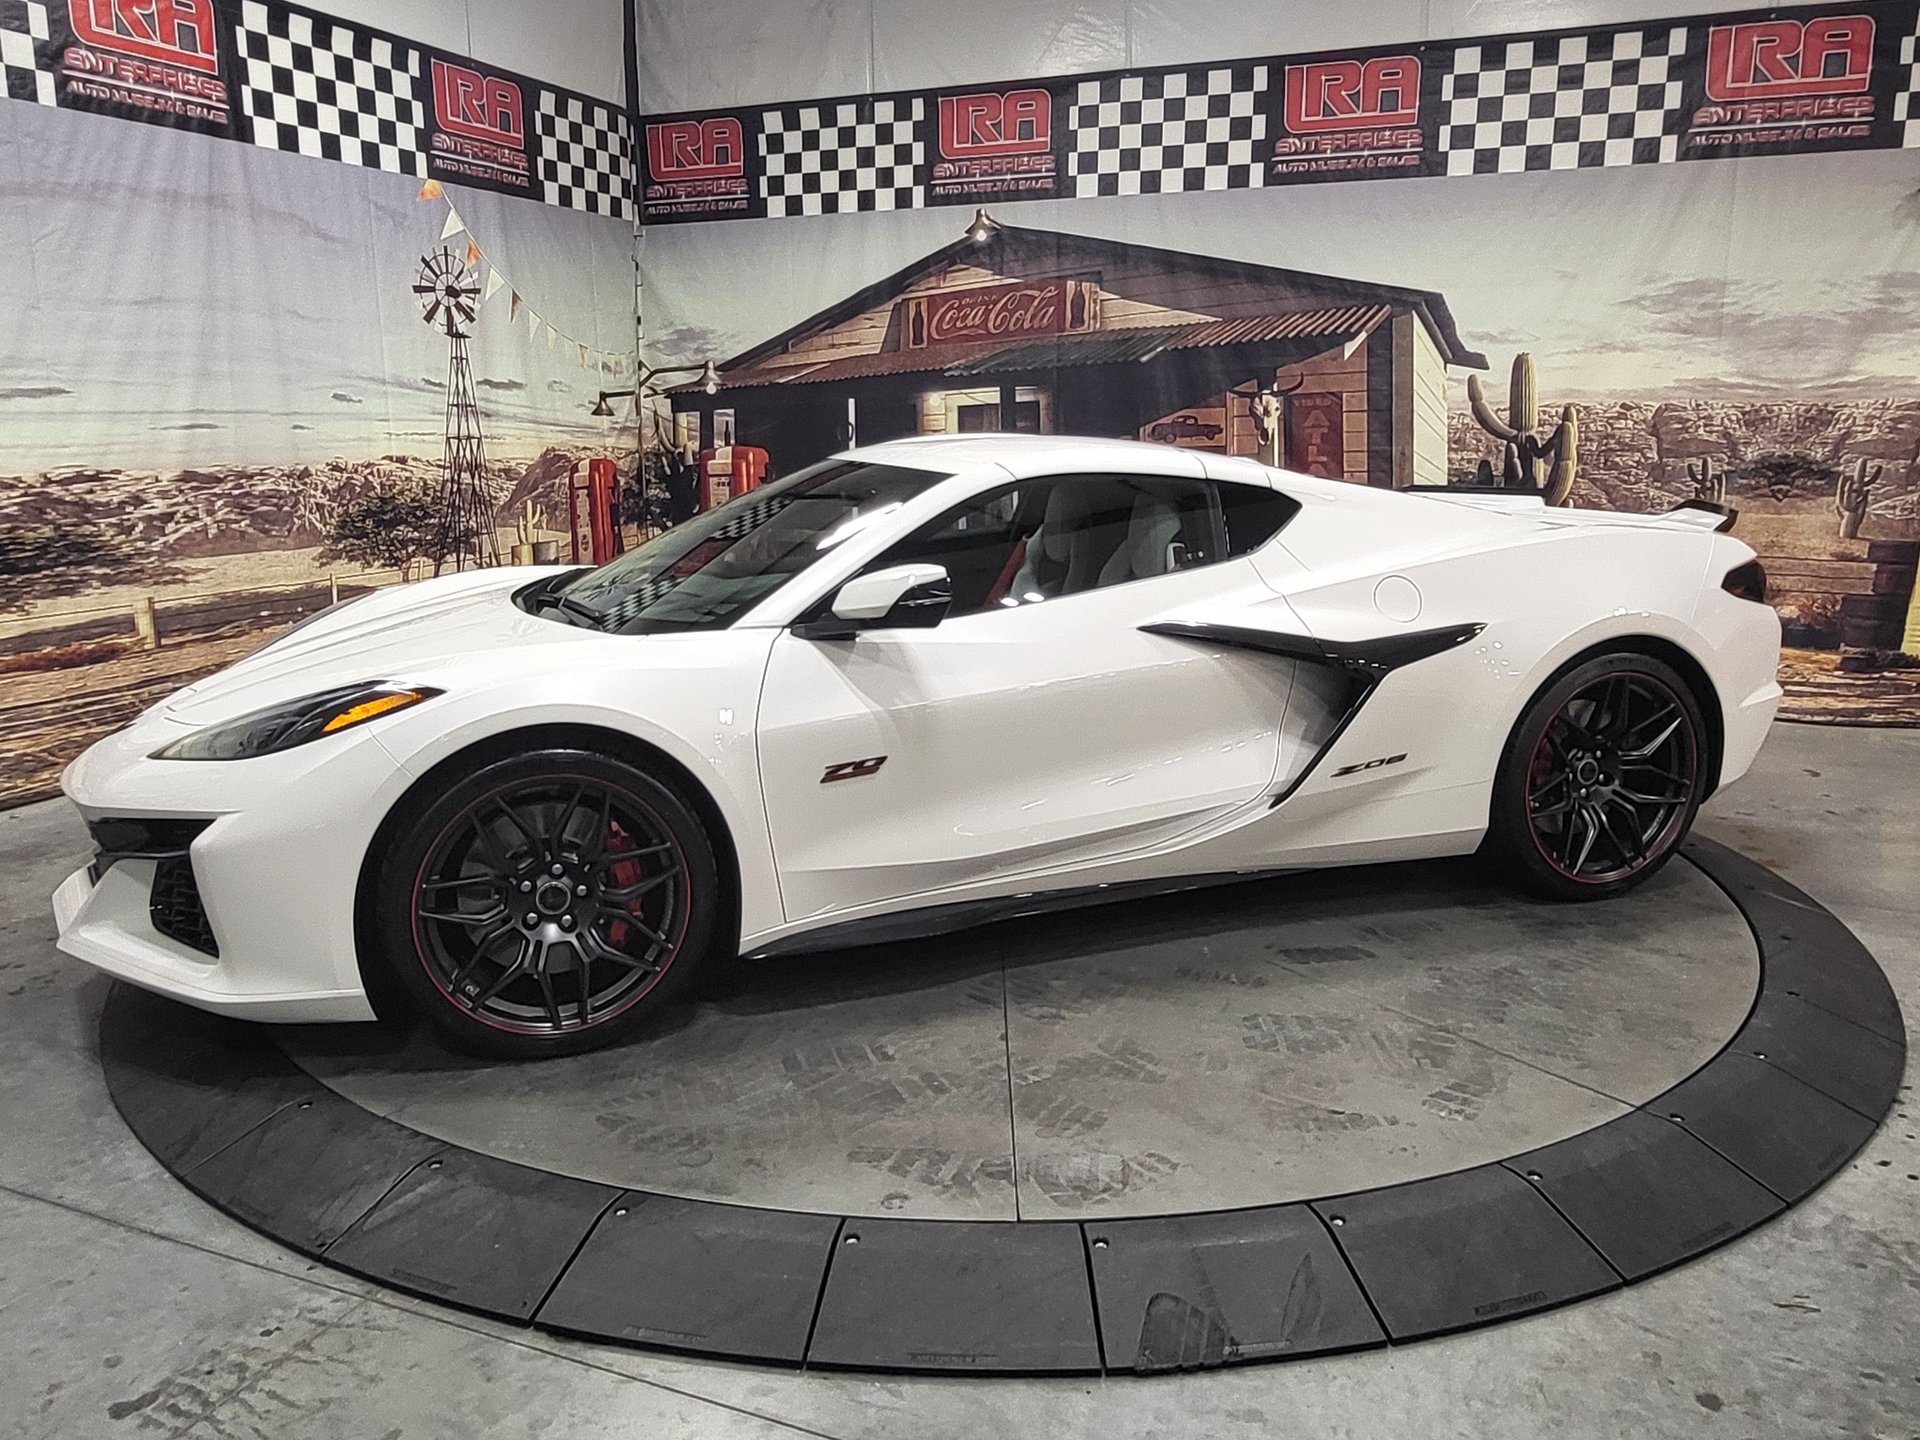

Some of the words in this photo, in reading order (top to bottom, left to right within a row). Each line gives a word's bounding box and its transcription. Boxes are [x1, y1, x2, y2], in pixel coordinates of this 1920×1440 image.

[64, 47, 228, 101] ENTERPRISES
[1705, 14, 1876, 102] LRA
[66, 80, 110, 98] AUTO
[431, 58, 524, 150] LRA
[1284, 55, 1421, 134] LRA
[938, 88, 1051, 160] LRA
[1693, 96, 1875, 126] ENTERPRISES
[646, 117, 744, 182] LRA
[1275, 129, 1423, 154] ENTERPRISES
[1689, 133, 1732, 147] AUTO
[933, 155, 1056, 178] ENTERPRISES
[1272, 162, 1308, 174] AUTO
